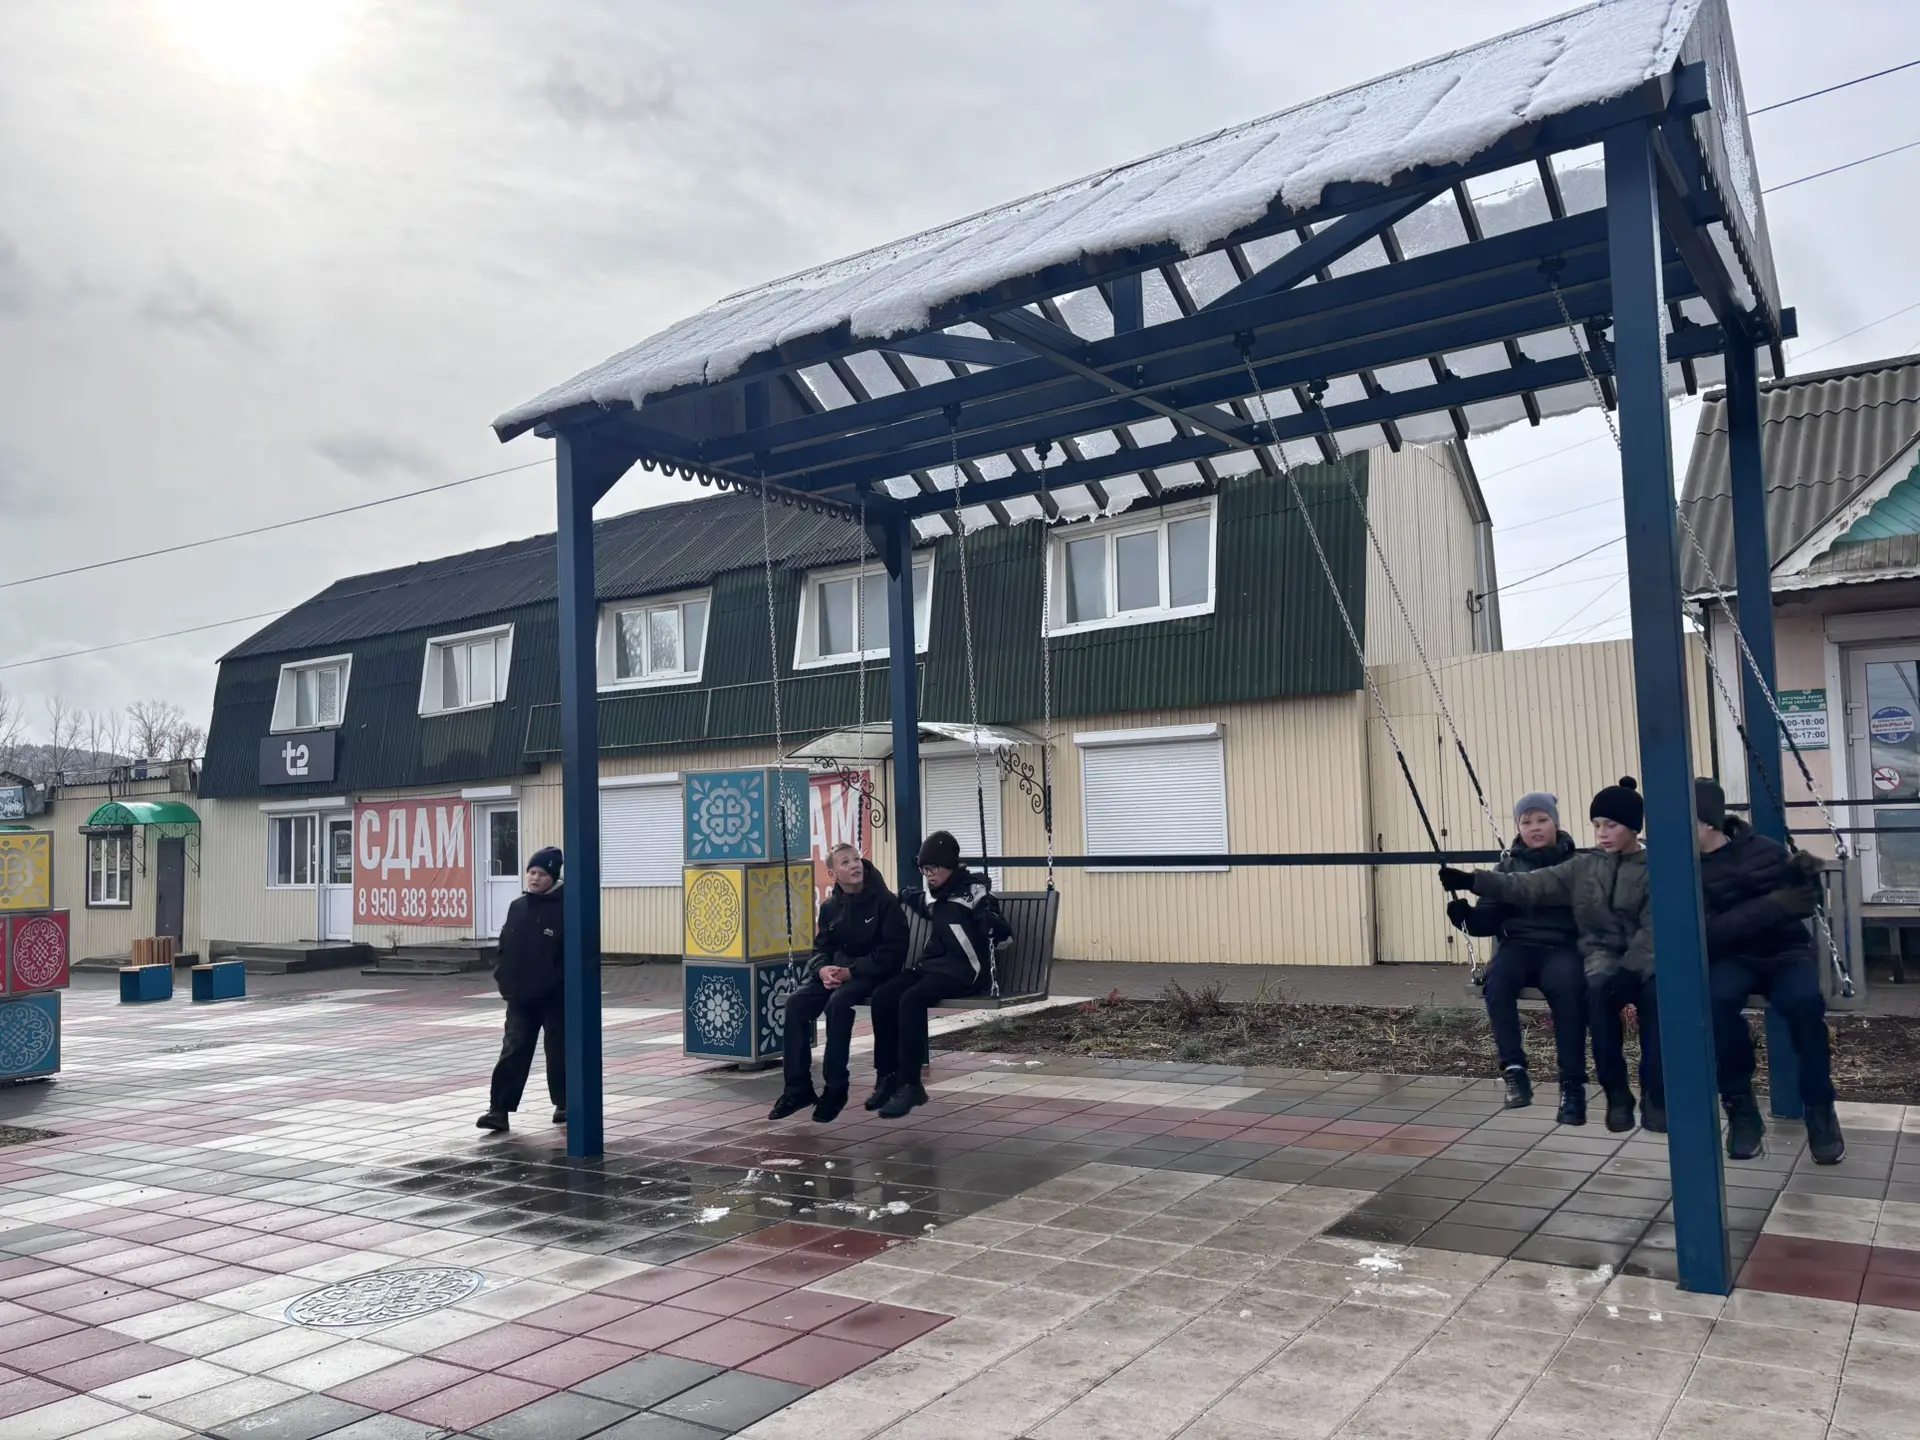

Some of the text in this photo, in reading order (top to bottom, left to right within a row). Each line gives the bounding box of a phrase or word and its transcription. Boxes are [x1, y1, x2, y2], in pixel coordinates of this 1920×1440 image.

[1786, 718, 1825, 727] 00-18:00
[281, 740, 310, 776] t2
[359, 805, 465, 881] СДАМ
[358, 887, 468, 919] 8 950 383 3333
